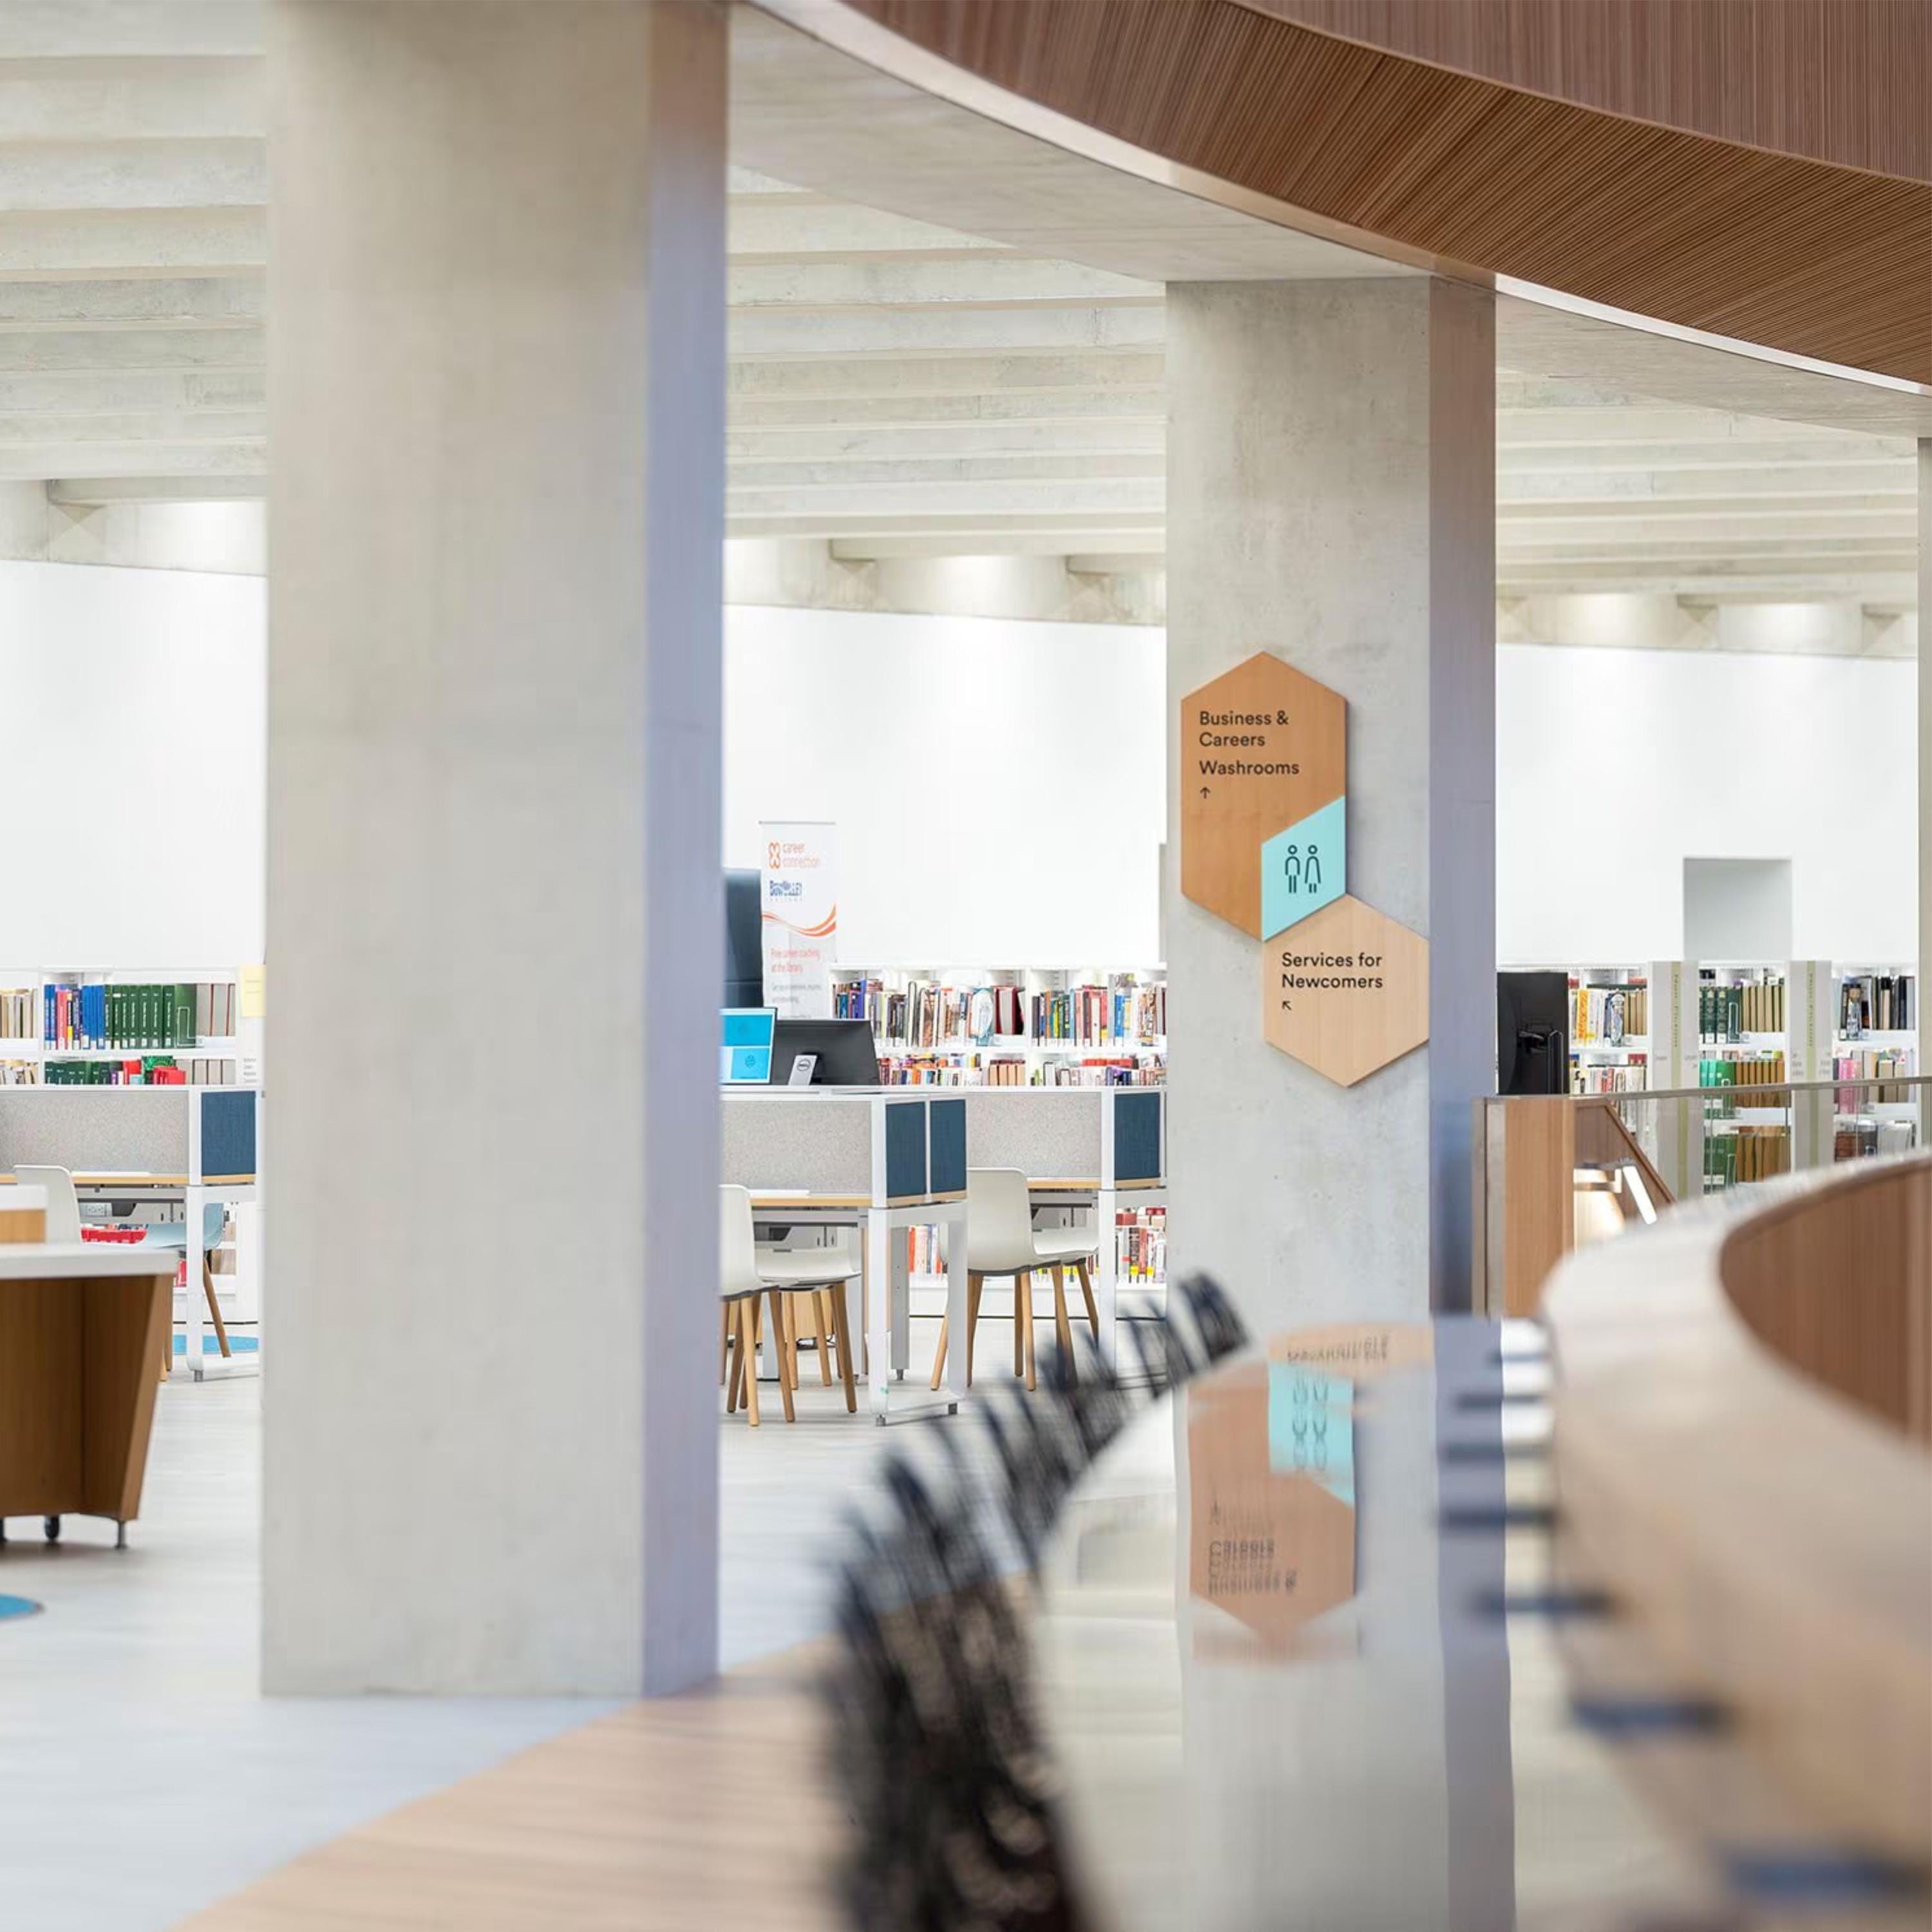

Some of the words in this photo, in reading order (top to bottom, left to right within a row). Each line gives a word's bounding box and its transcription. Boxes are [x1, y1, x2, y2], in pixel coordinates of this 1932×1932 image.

[1199, 710, 1272, 726] Business
[1276, 710, 1289, 726] &
[1199, 732, 1266, 747] Careers
[1198, 759, 1300, 775] Washrooms
[1282, 951, 1354, 967] Services
[1358, 951, 1383, 967] for
[1282, 973, 1383, 989] Newcomers
